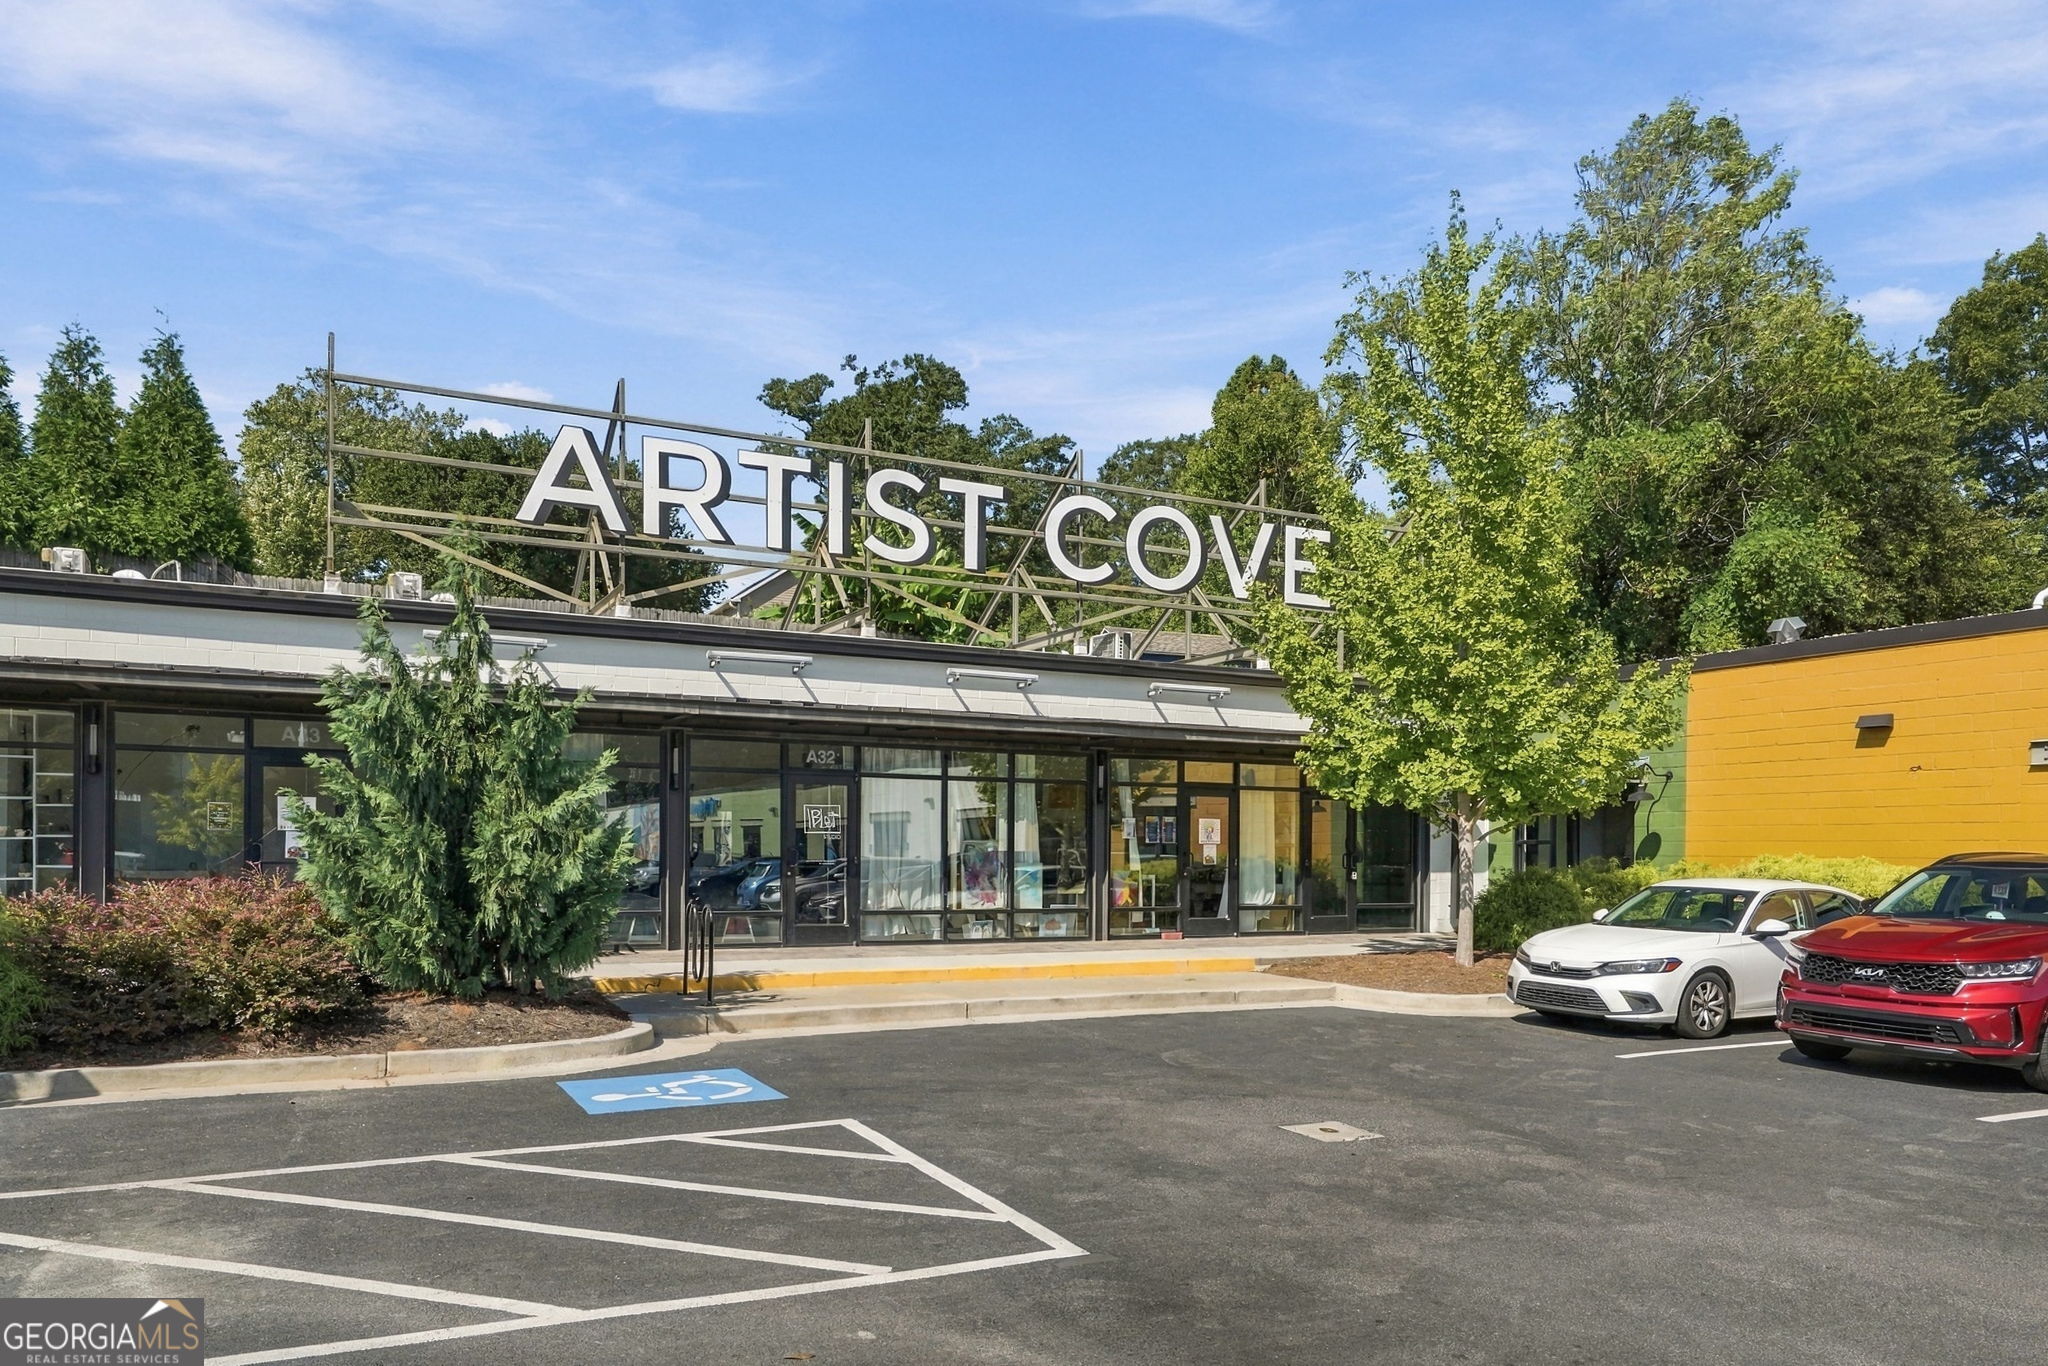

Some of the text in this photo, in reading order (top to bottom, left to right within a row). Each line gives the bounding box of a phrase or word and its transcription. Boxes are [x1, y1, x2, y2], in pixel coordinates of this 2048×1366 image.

[515, 424, 1333, 609] ARTIST COVE
[805, 749, 836, 764] A32
